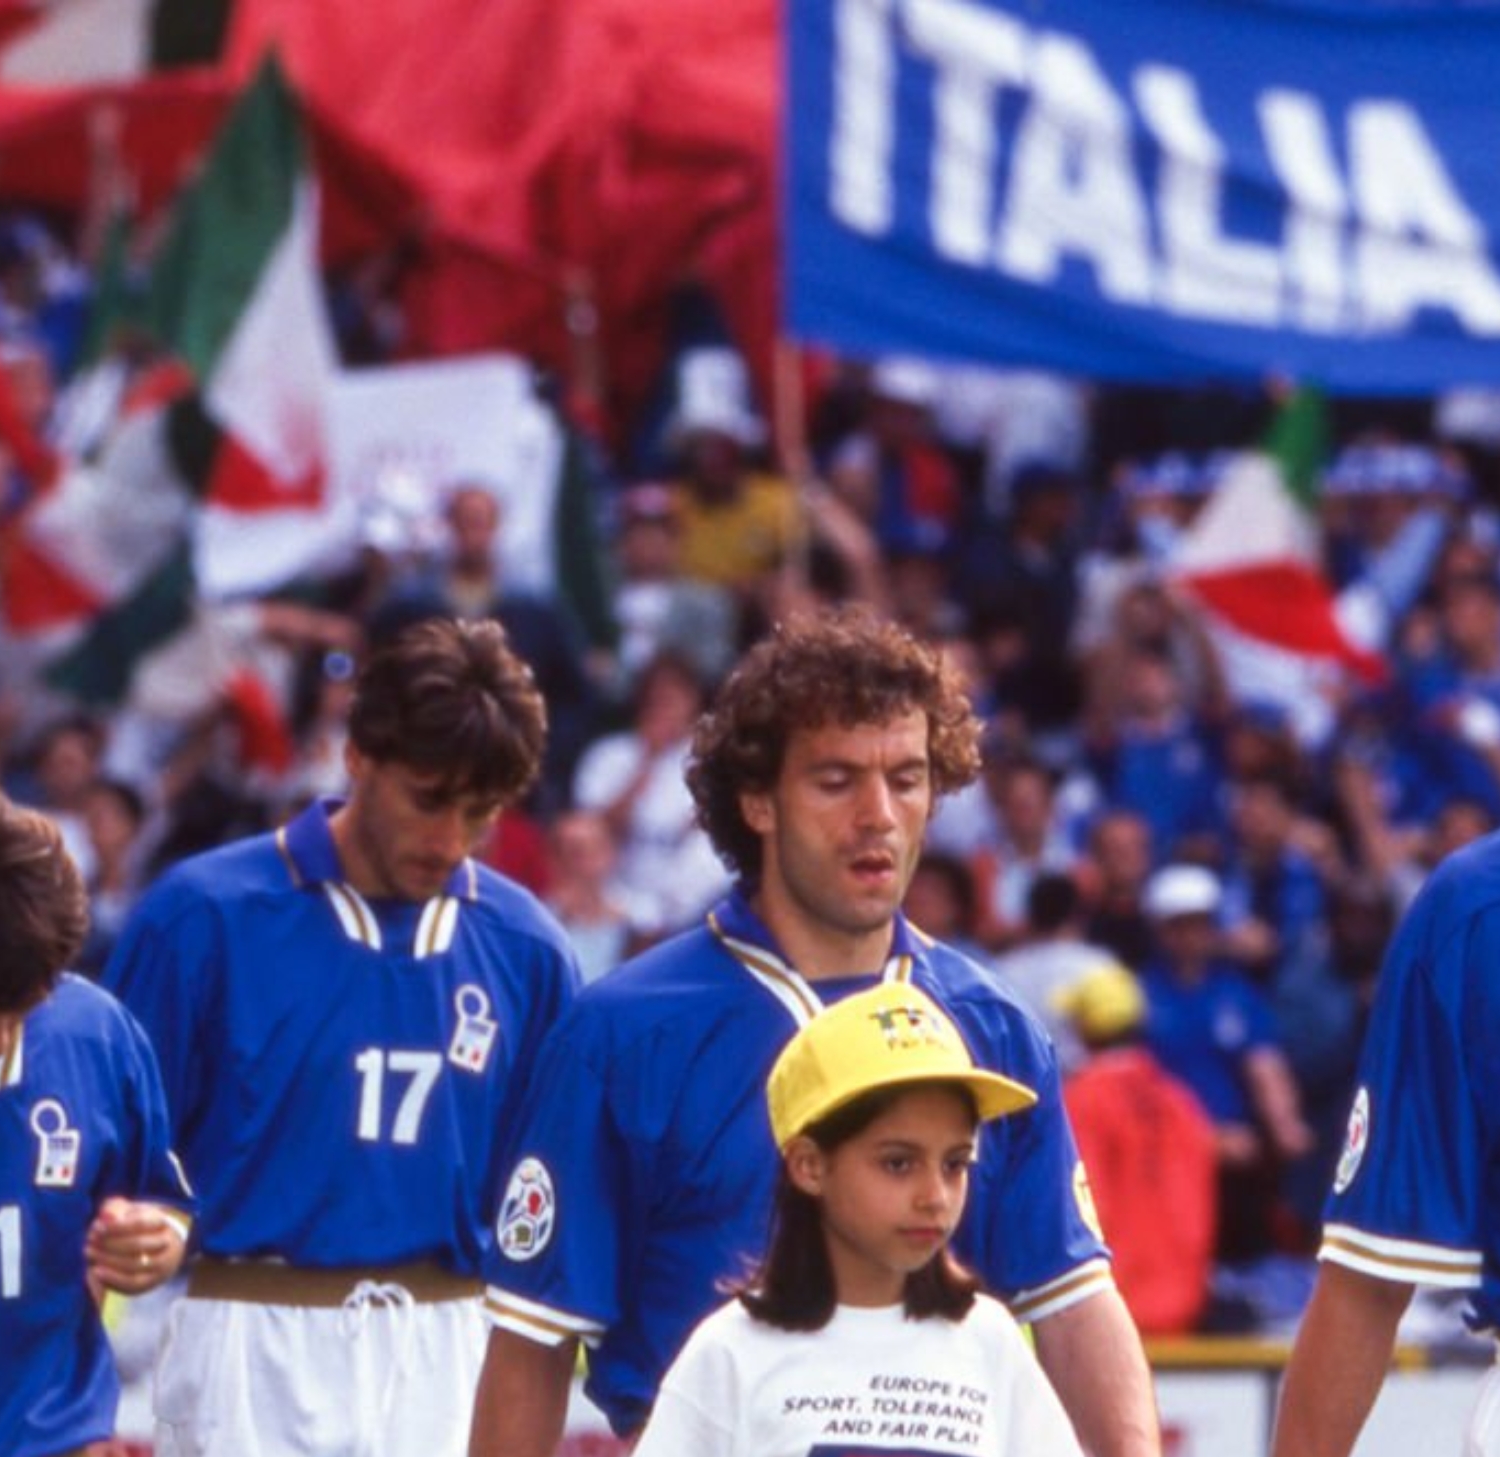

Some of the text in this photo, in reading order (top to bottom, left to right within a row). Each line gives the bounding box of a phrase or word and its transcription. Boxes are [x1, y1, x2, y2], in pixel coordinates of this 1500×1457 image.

[355, 1049, 442, 1144] 17
[869, 1374, 953, 1396] EUROPE
[781, 1396, 863, 1414] SPORT,
[822, 1418, 874, 1437] AND
[878, 1420, 930, 1440] FAIR
